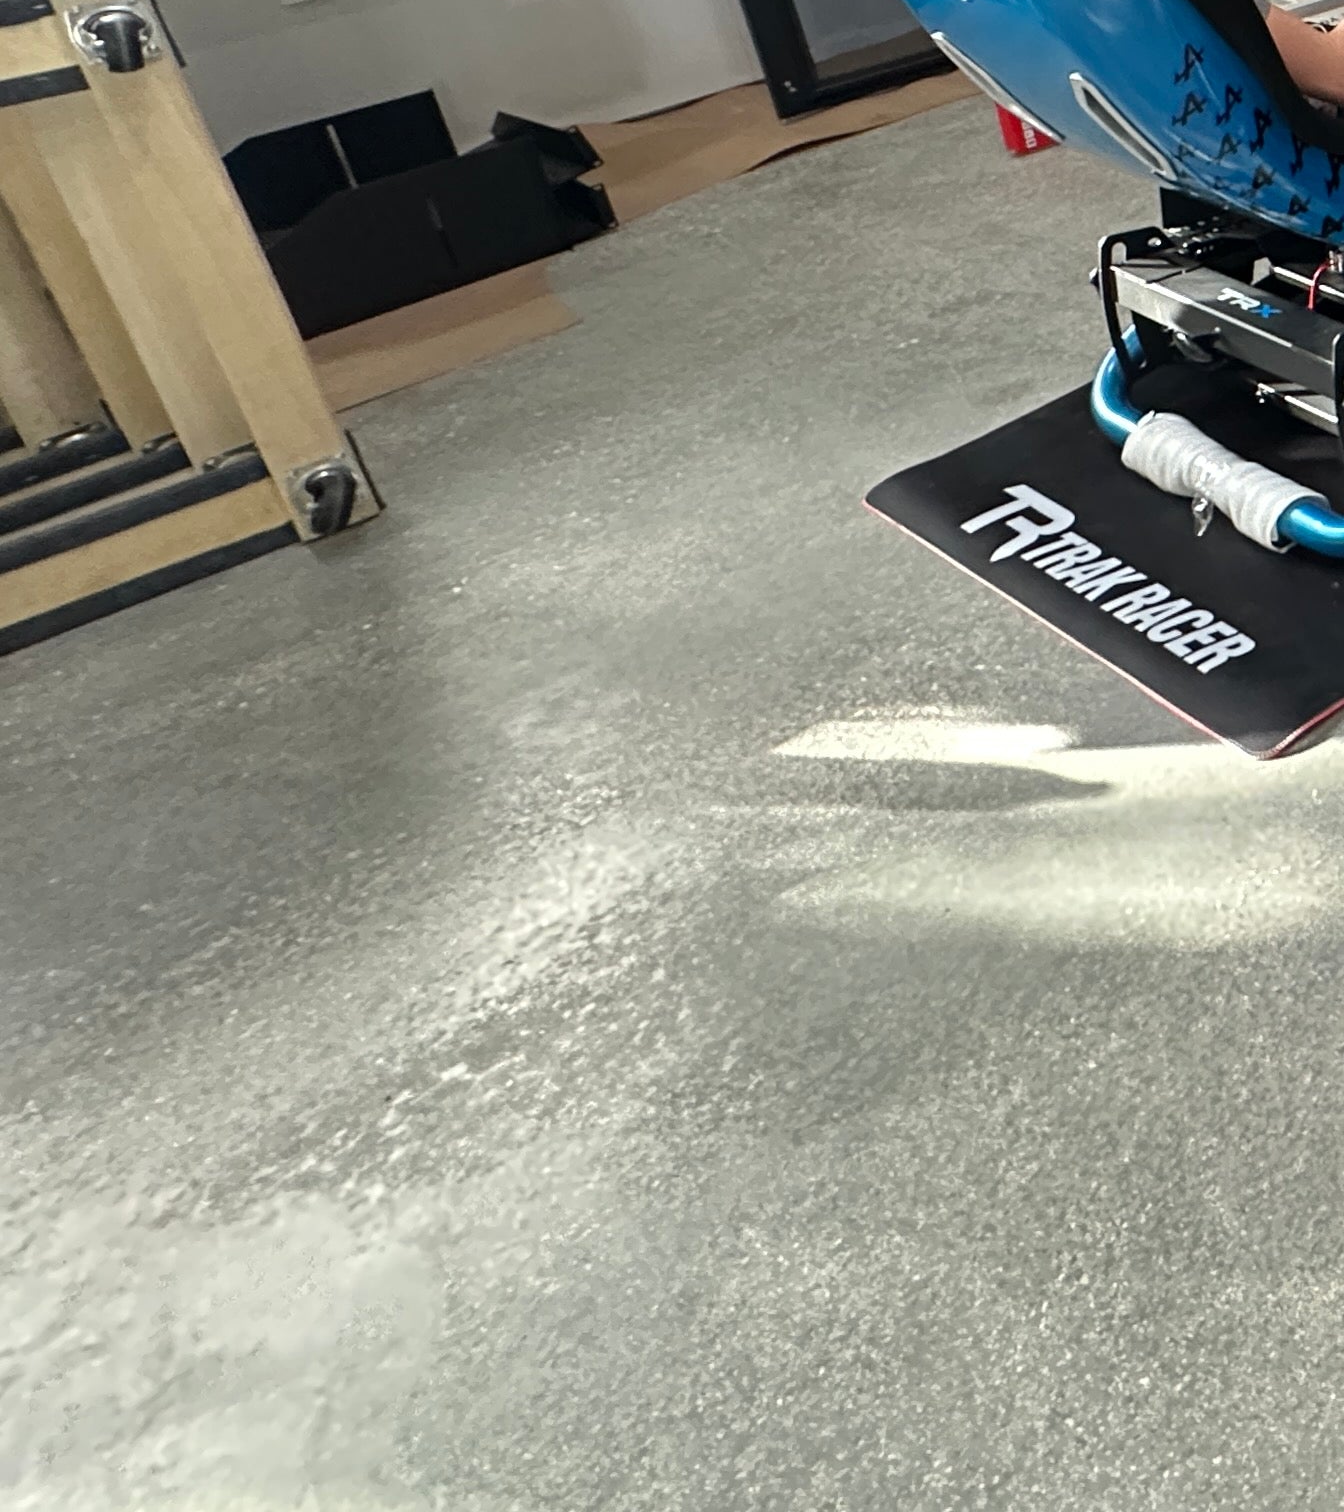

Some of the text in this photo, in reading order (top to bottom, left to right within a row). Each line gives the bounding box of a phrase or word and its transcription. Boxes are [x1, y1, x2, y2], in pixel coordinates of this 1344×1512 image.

[1217, 287, 1283, 319] TRX
[1021, 531, 1136, 602] TRAK
[1101, 581, 1257, 675] RACER
